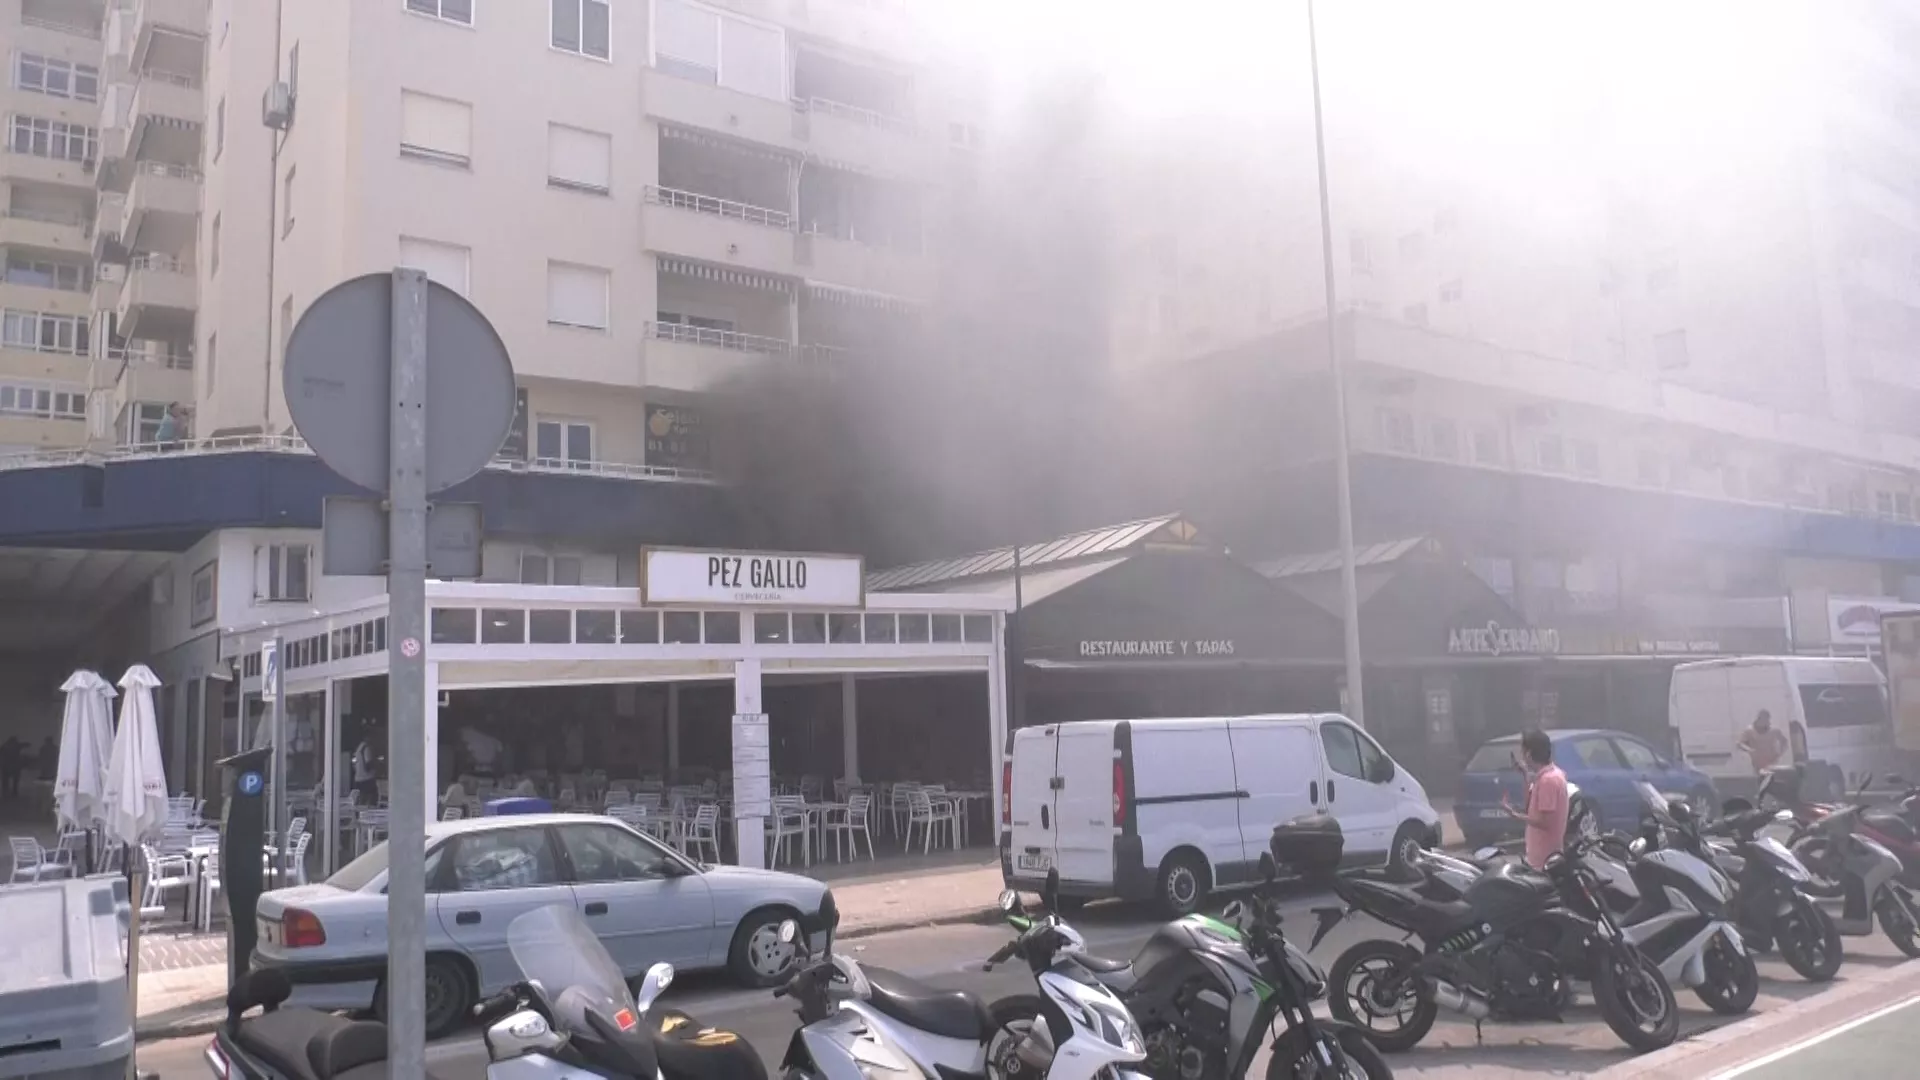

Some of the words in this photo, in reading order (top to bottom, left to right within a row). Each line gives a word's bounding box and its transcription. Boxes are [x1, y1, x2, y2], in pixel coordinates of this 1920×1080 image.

[708, 557, 742, 587] PEZ
[750, 559, 807, 589] GALLO
[1079, 639, 1175, 656] RESTAURANTE
[1180, 640, 1189, 655] Y
[1195, 639, 1235, 655] TAPAS
